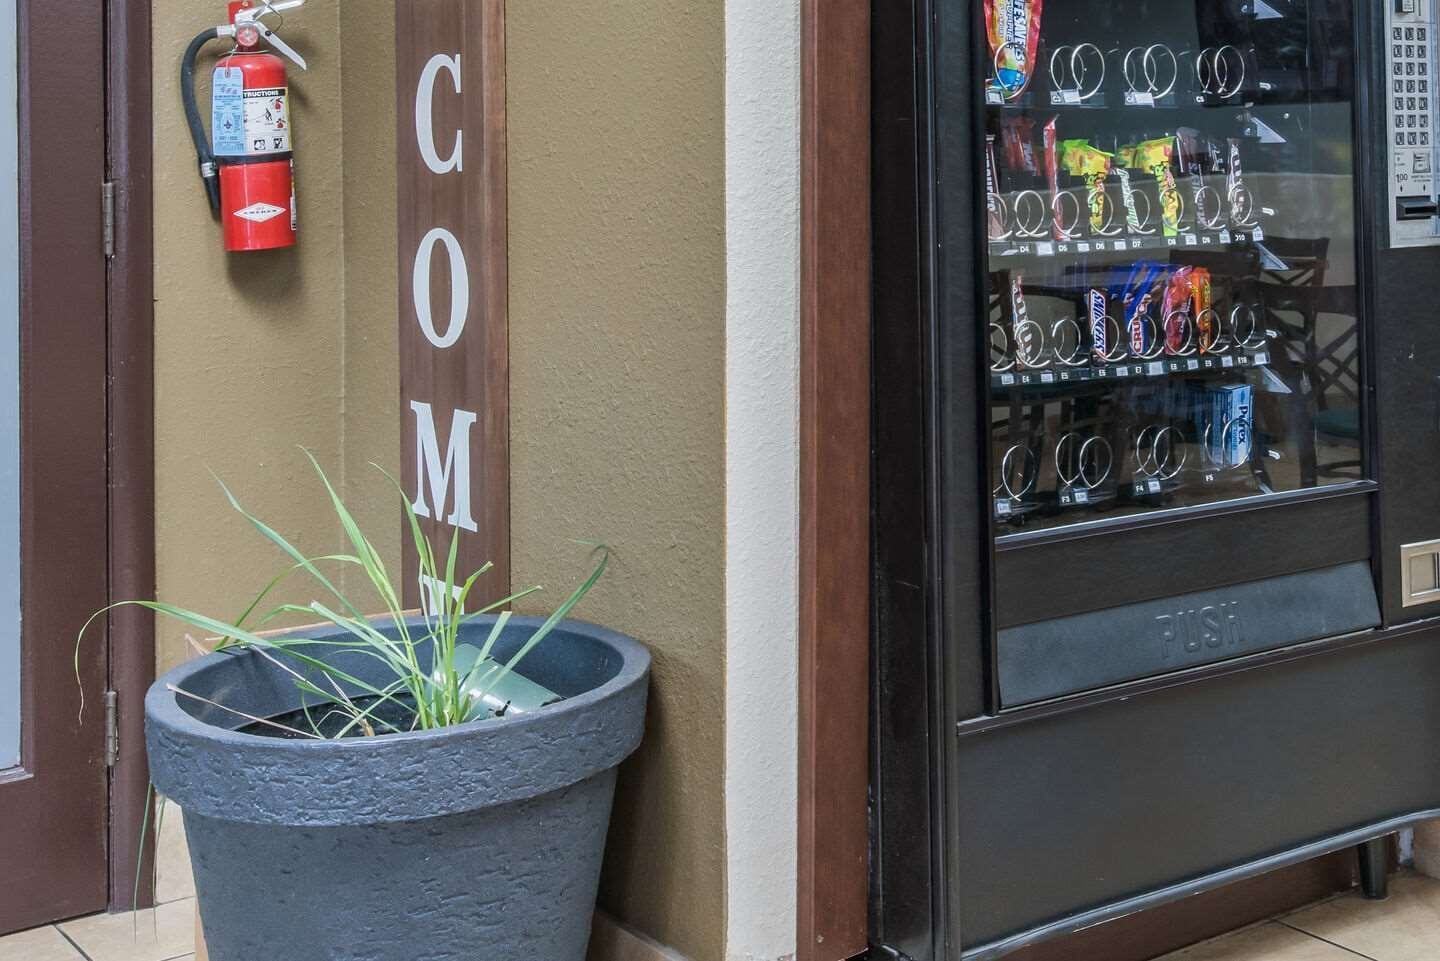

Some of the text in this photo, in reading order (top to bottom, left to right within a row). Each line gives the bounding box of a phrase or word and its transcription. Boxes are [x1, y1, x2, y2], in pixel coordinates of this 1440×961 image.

[243, 90, 279, 98] TRUCTIONS
[1092, 290, 1105, 355] SNICKERS
[1238, 406, 1249, 444] Purex
[1154, 601, 1239, 659] PUSH
